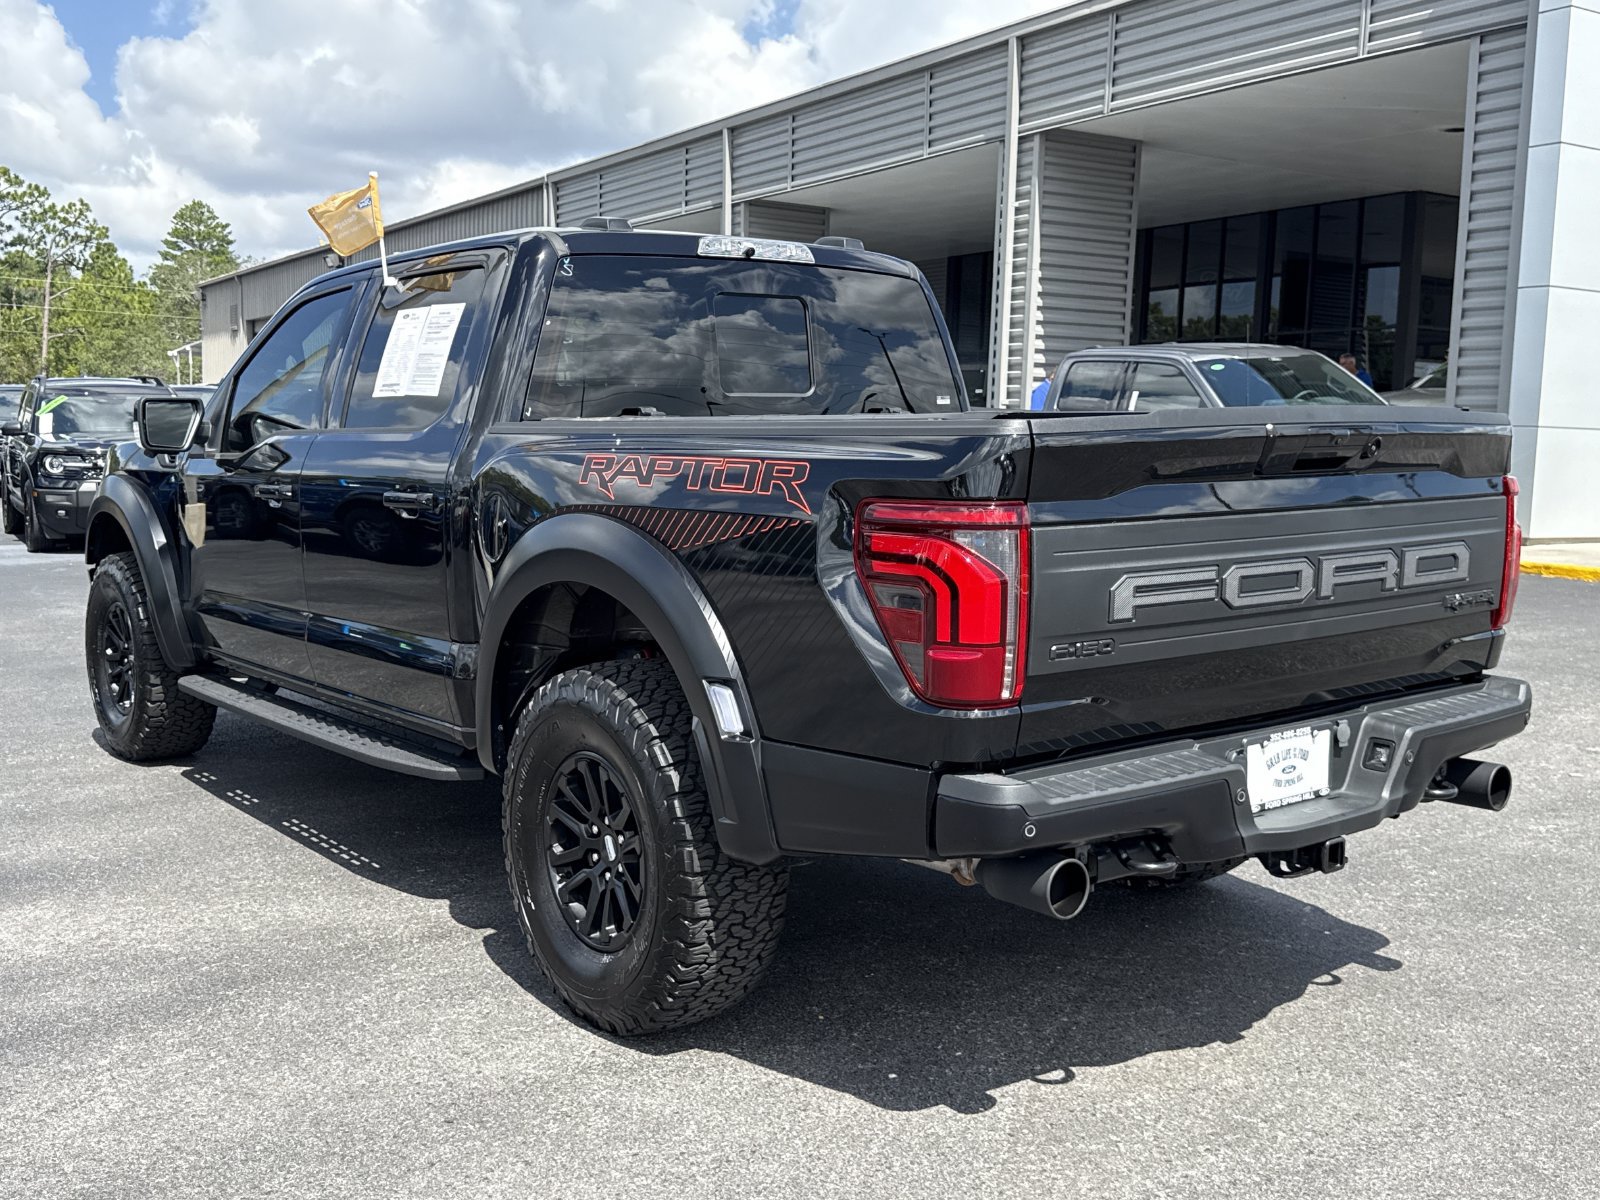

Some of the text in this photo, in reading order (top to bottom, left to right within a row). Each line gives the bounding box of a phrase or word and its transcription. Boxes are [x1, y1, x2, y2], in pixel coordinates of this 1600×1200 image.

[579, 454, 811, 516] RAPTOR
[1108, 540, 1471, 624] FORD
[1265, 800, 1281, 810] FORD
[1281, 793, 1302, 806] SPRING
[1303, 791, 1315, 801] HILL
